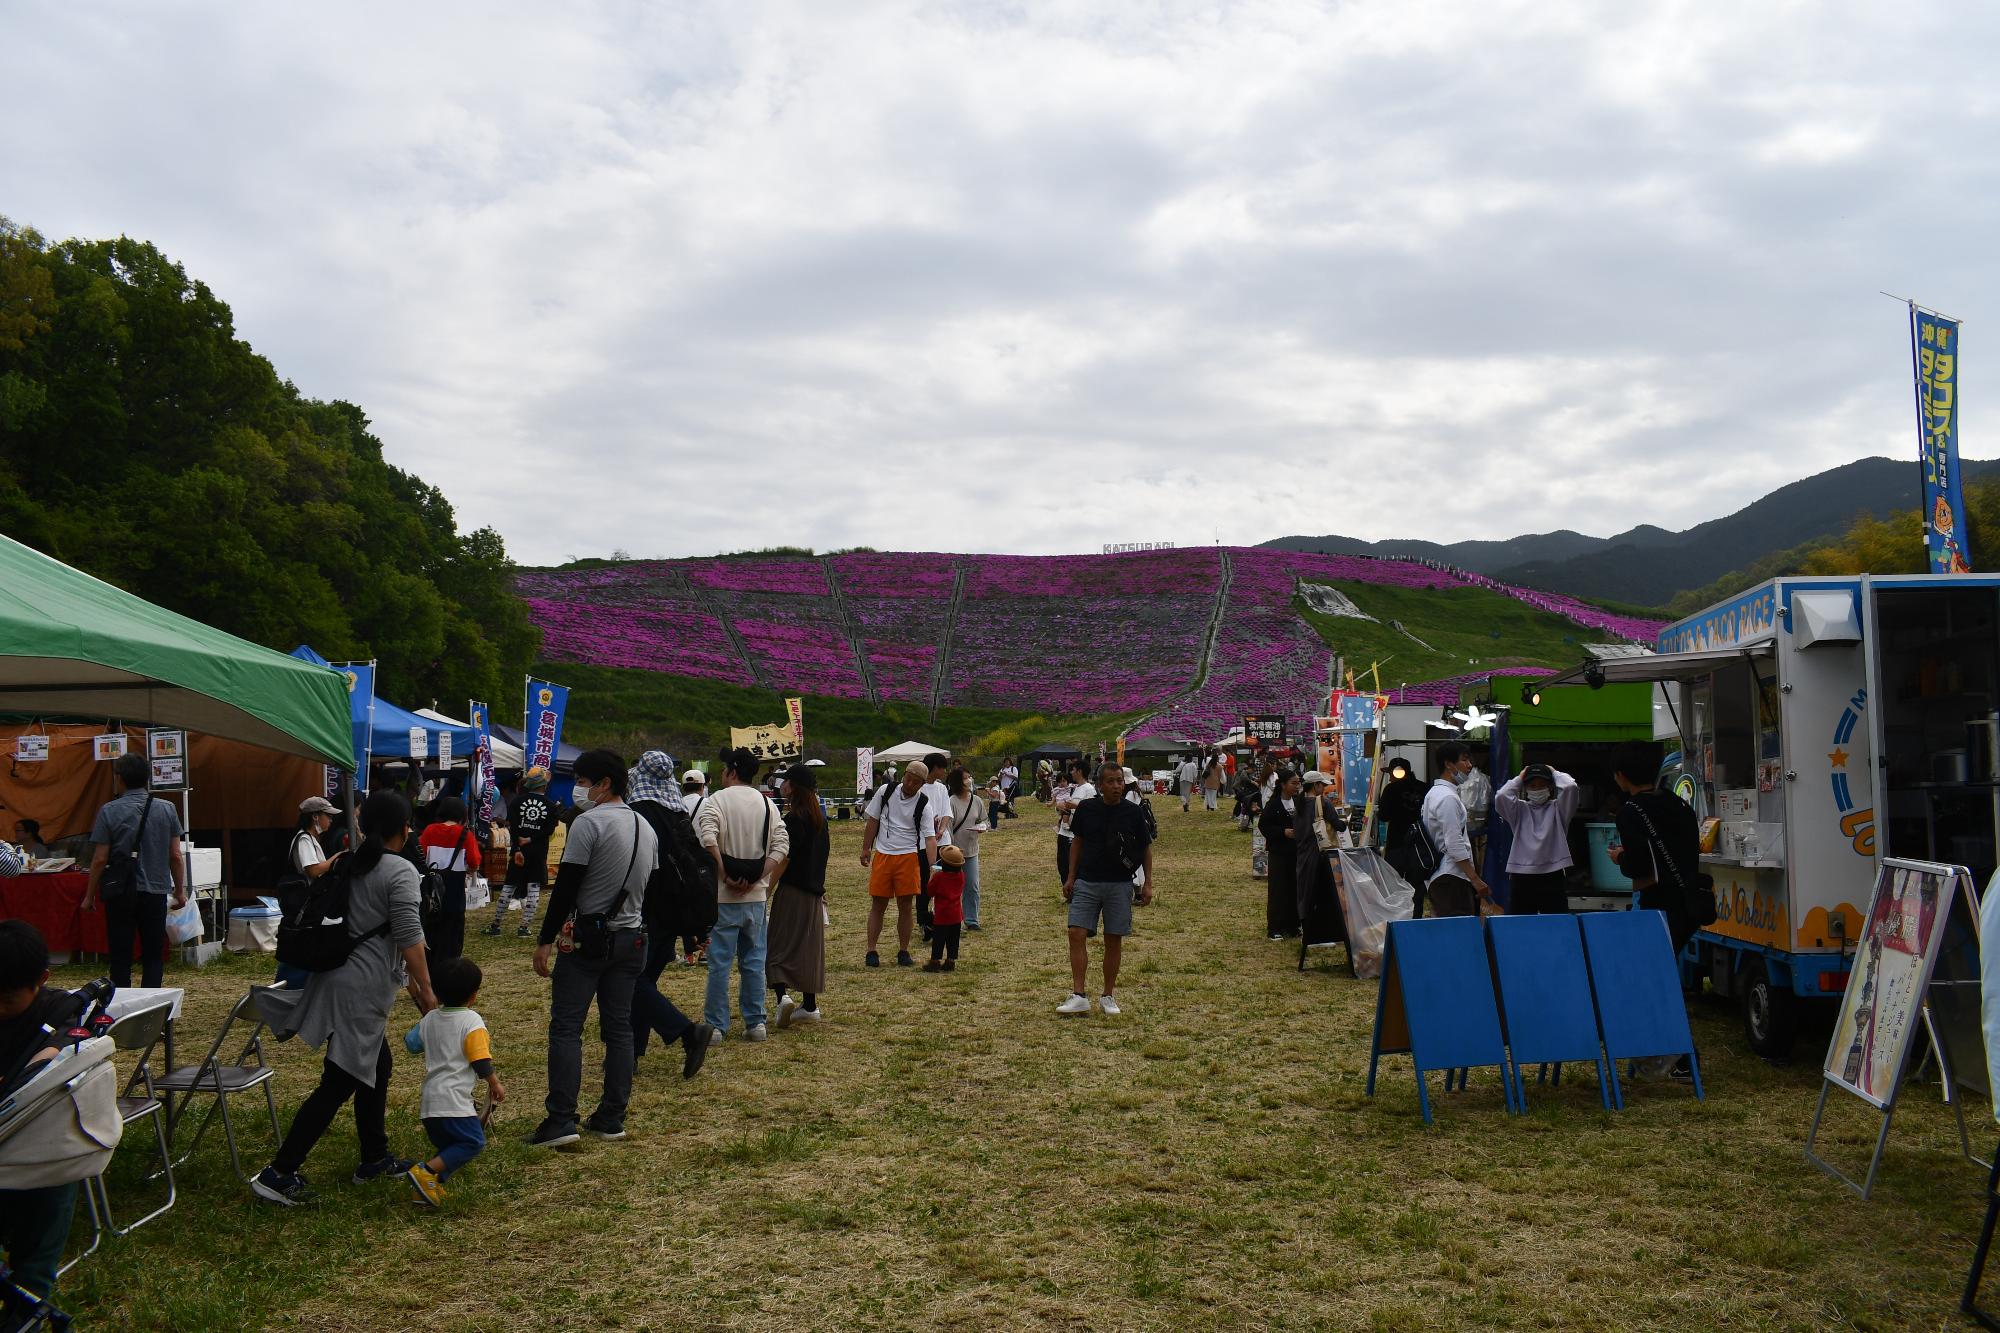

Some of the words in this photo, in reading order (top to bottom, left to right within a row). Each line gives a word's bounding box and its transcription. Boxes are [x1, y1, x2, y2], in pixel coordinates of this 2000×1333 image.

[1103, 541, 1175, 555] KATSURAGI
[1705, 608, 1736, 648] TACO
[1739, 595, 1770, 639] RICE
[1251, 730, 1281, 740] からあげ
[1878, 971, 1906, 1062] バナナジュース
